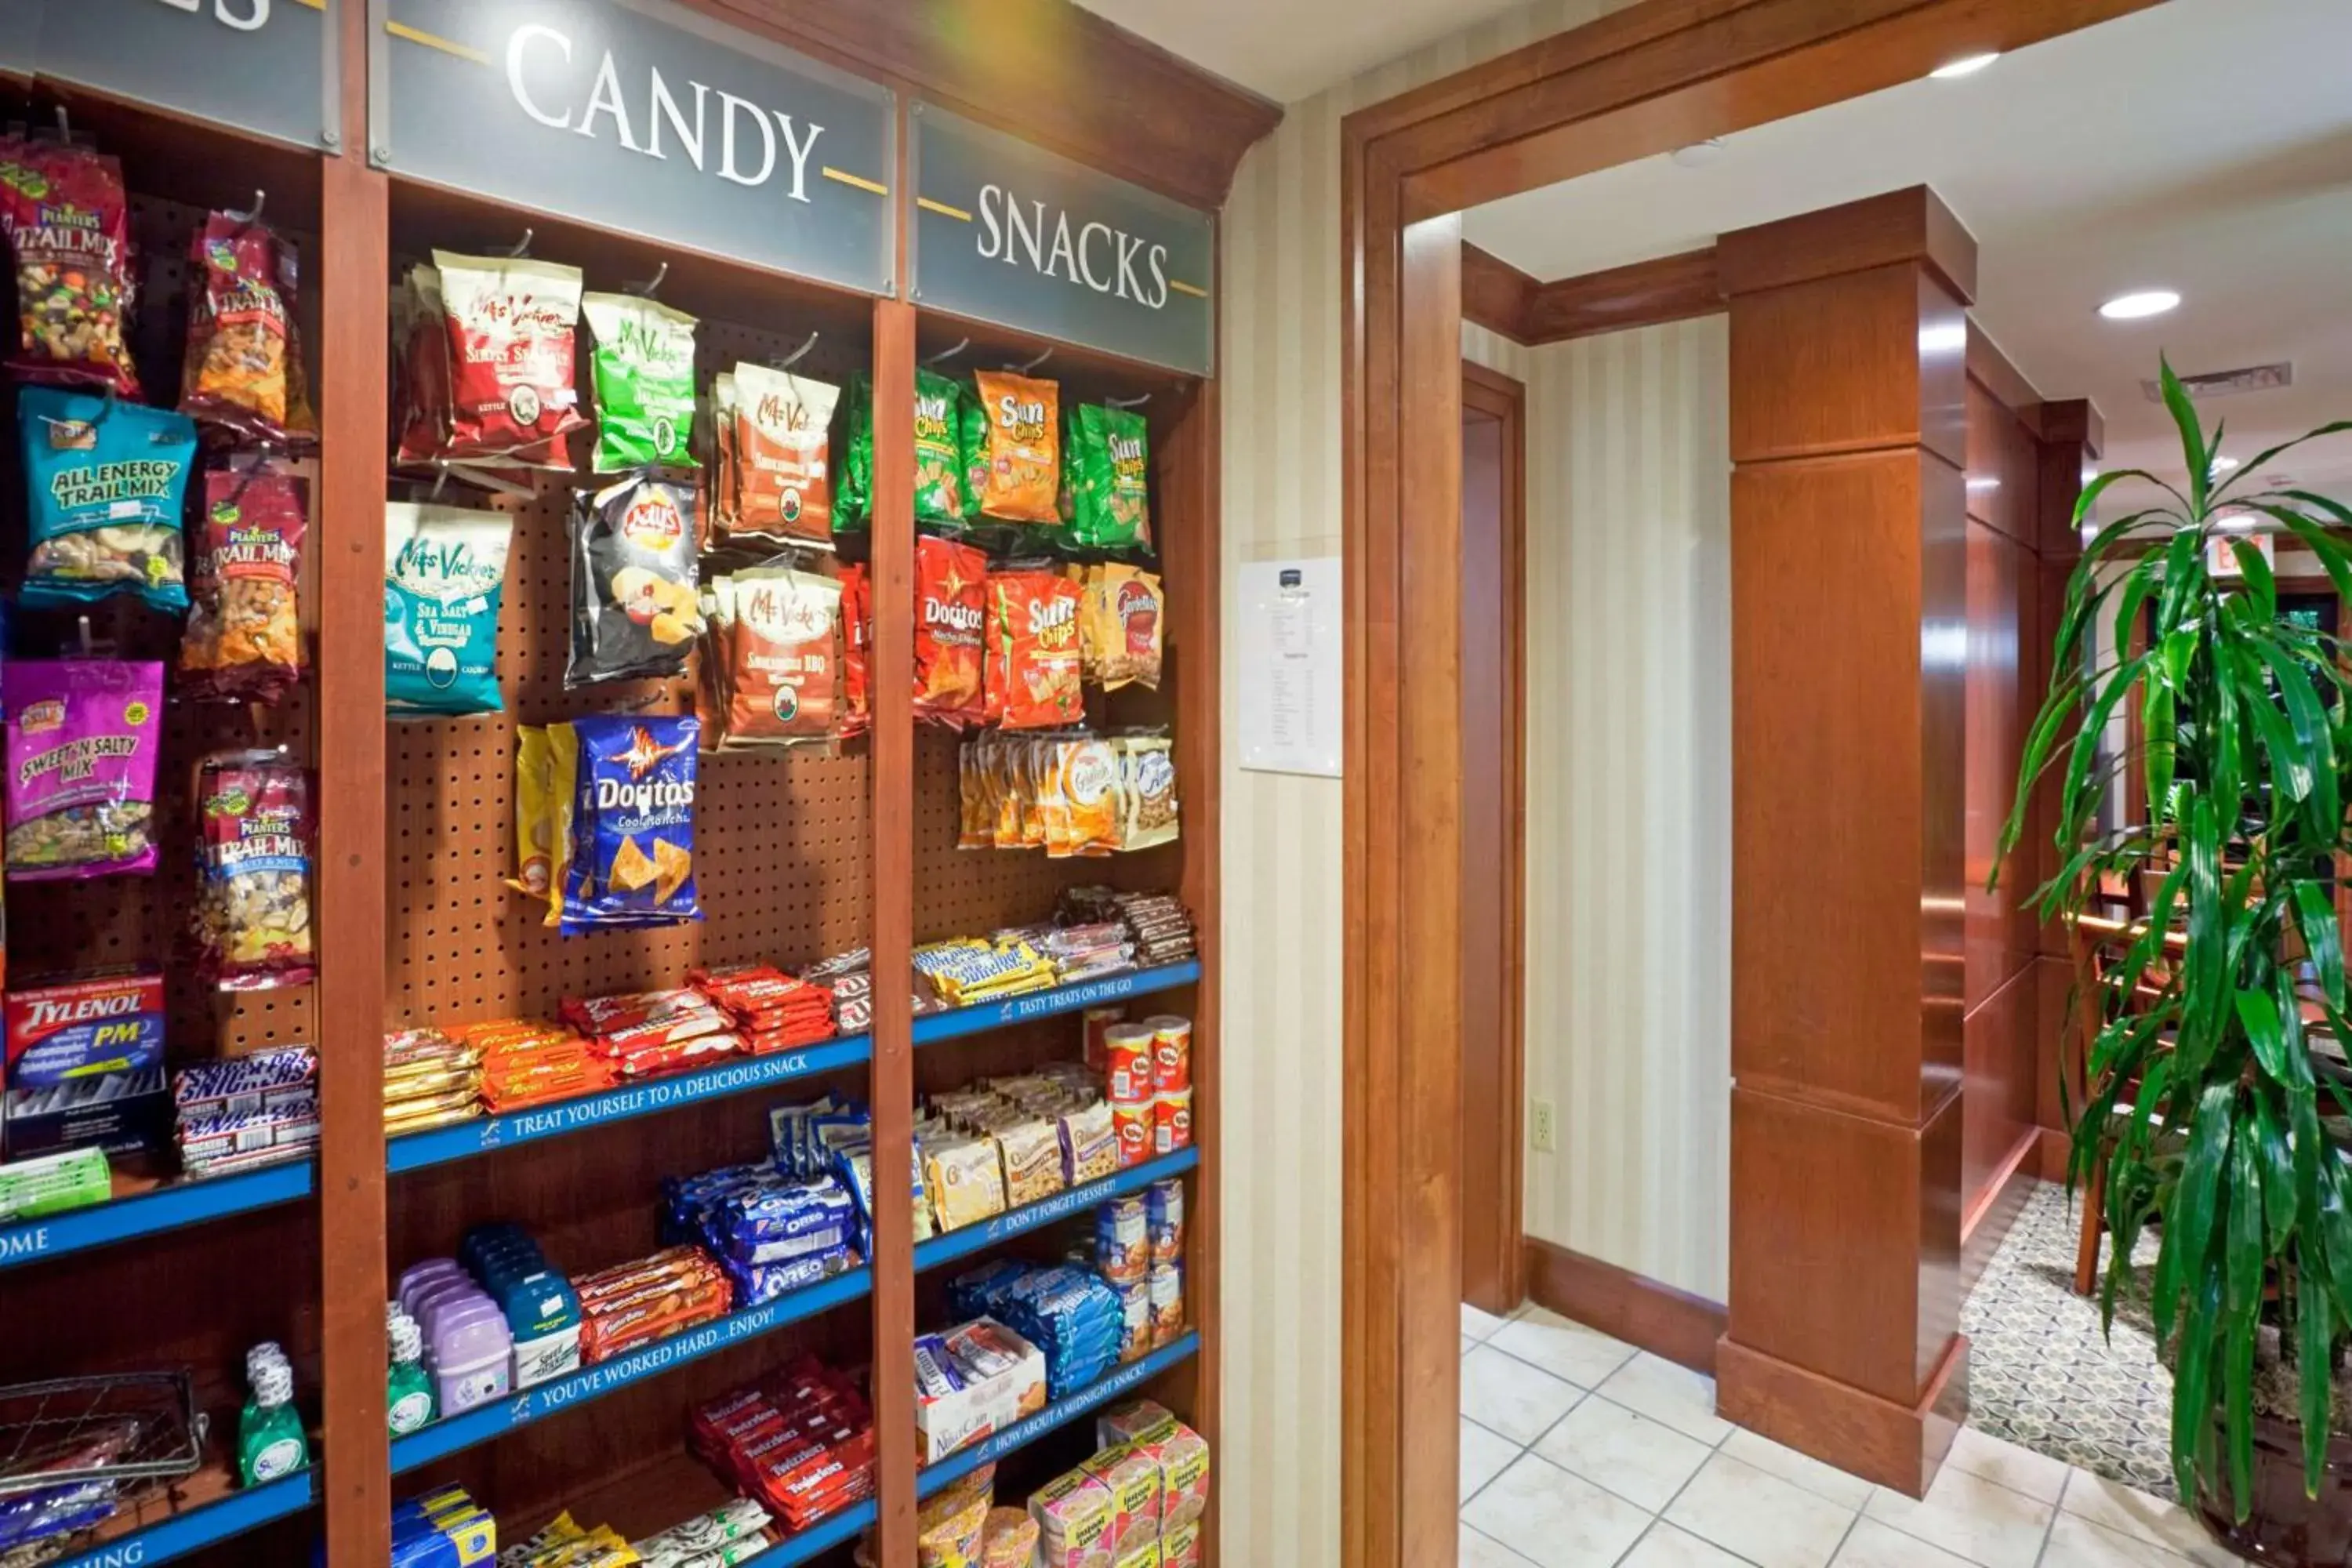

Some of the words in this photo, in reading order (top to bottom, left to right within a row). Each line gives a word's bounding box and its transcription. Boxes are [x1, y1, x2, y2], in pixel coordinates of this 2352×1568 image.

[506, 24, 824, 202] CANDY
[978, 184, 1168, 309] SNACKS
[1000, 395, 1044, 427] Sun
[54, 469, 93, 492] ALL
[99, 461, 179, 481] ENERGY
[60, 483, 122, 507] TRAIL
[129, 478, 169, 496] MIX
[1029, 594, 1076, 633] Sun
[24, 745, 71, 779] SWEET
[94, 737, 136, 755] SALTY
[63, 758, 92, 779] MIX
[598, 776, 695, 810] Doritos
[24, 993, 143, 1034] TYLENOL
[1019, 996, 1047, 1014] TASTY
[1049, 989, 1081, 1009] TREATS
[1082, 986, 1097, 1001] ON
[1098, 980, 1117, 997] THE
[1117, 978, 1132, 993] GO
[93, 1022, 142, 1048] PM
[514, 1109, 564, 1138] TREAT
[567, 1091, 646, 1126] YOURSELF
[648, 1085, 670, 1105] TO
[672, 1083, 684, 1100] A
[685, 1066, 761, 1096] DELICIOUS
[763, 1053, 808, 1079] SNACK
[786, 1212, 824, 1233] OREO
[1006, 1205, 1038, 1230] DON'T
[1040, 1193, 1076, 1218] FORGET
[1077, 1179, 1116, 1203] DESSERT!
[766, 1258, 823, 1298] OREO
[542, 1372, 603, 1407] YOU'VE
[603, 1348, 672, 1382] WORKED
[996, 1425, 1022, 1450] HOW
[1023, 1409, 1055, 1436] ABOUT
[1056, 1408, 1064, 1419] A
[1065, 1383, 1112, 1414] MIDNIGHT
[1114, 1363, 1145, 1388] SNACK?
